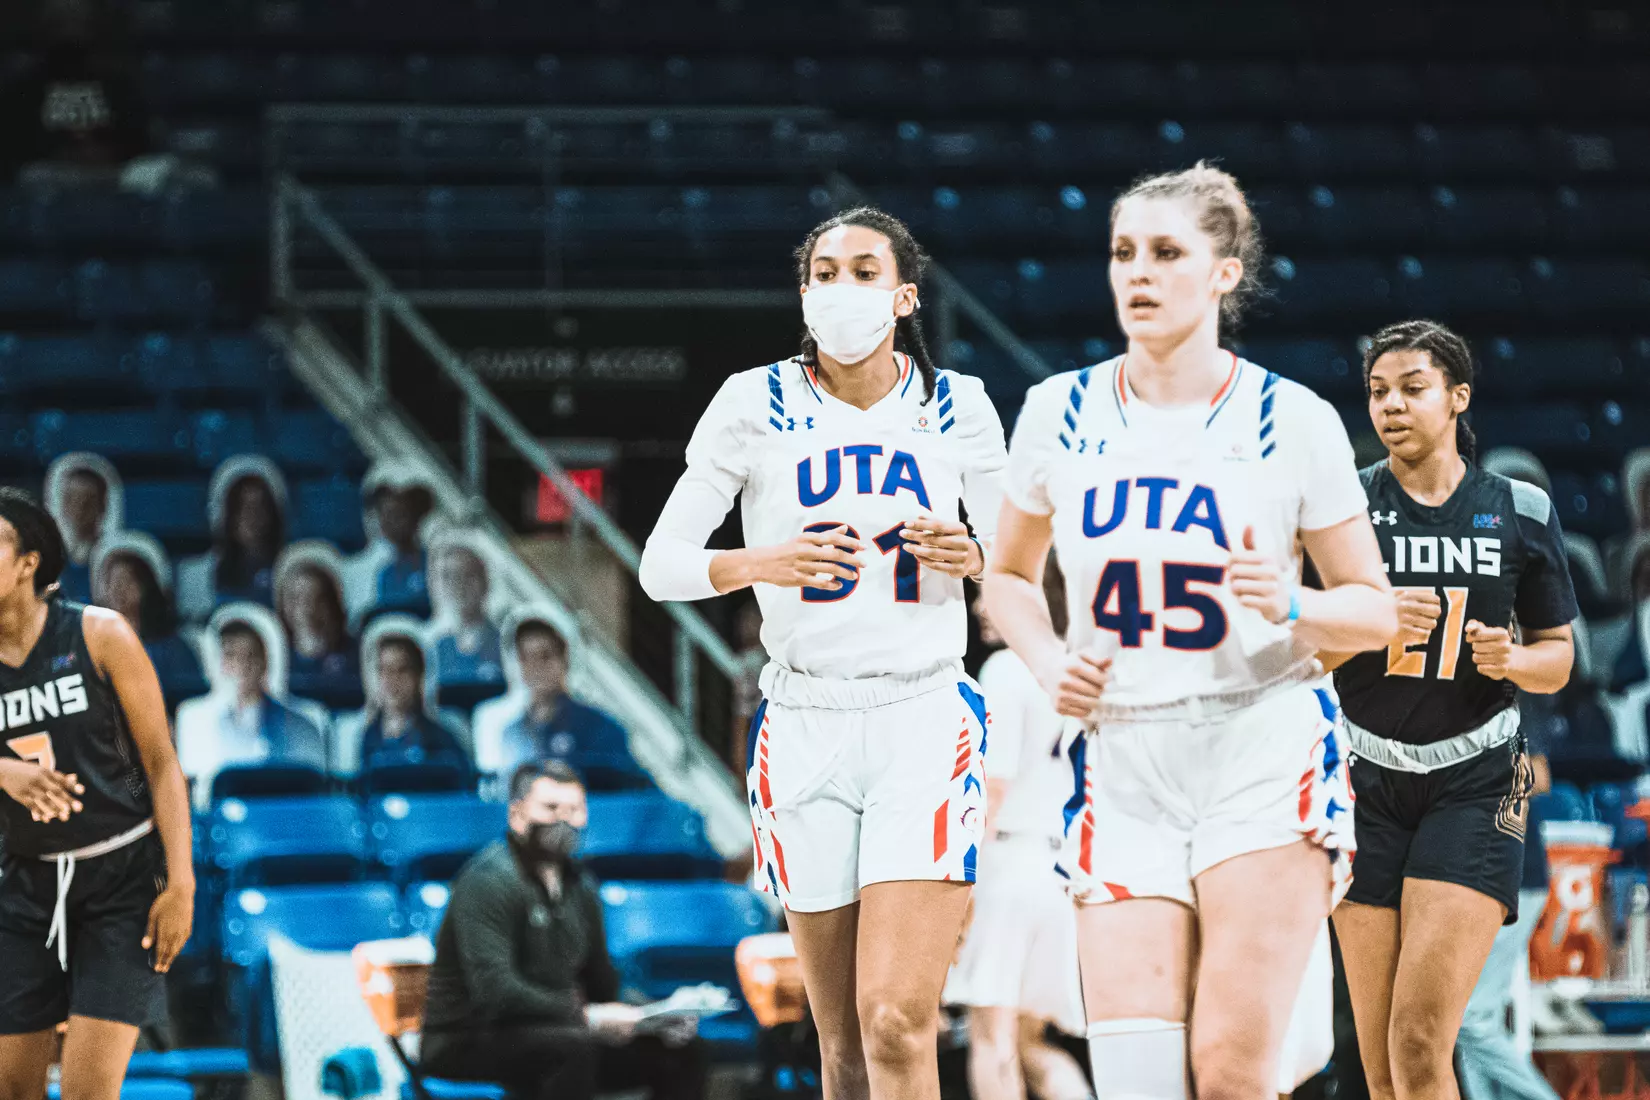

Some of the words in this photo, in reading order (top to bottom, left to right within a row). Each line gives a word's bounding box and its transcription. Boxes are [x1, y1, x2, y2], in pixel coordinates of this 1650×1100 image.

[797, 444, 933, 513] UTA
[1082, 476, 1231, 552] UTA
[1382, 536, 1501, 577] IONS
[1091, 558, 1230, 652] 45
